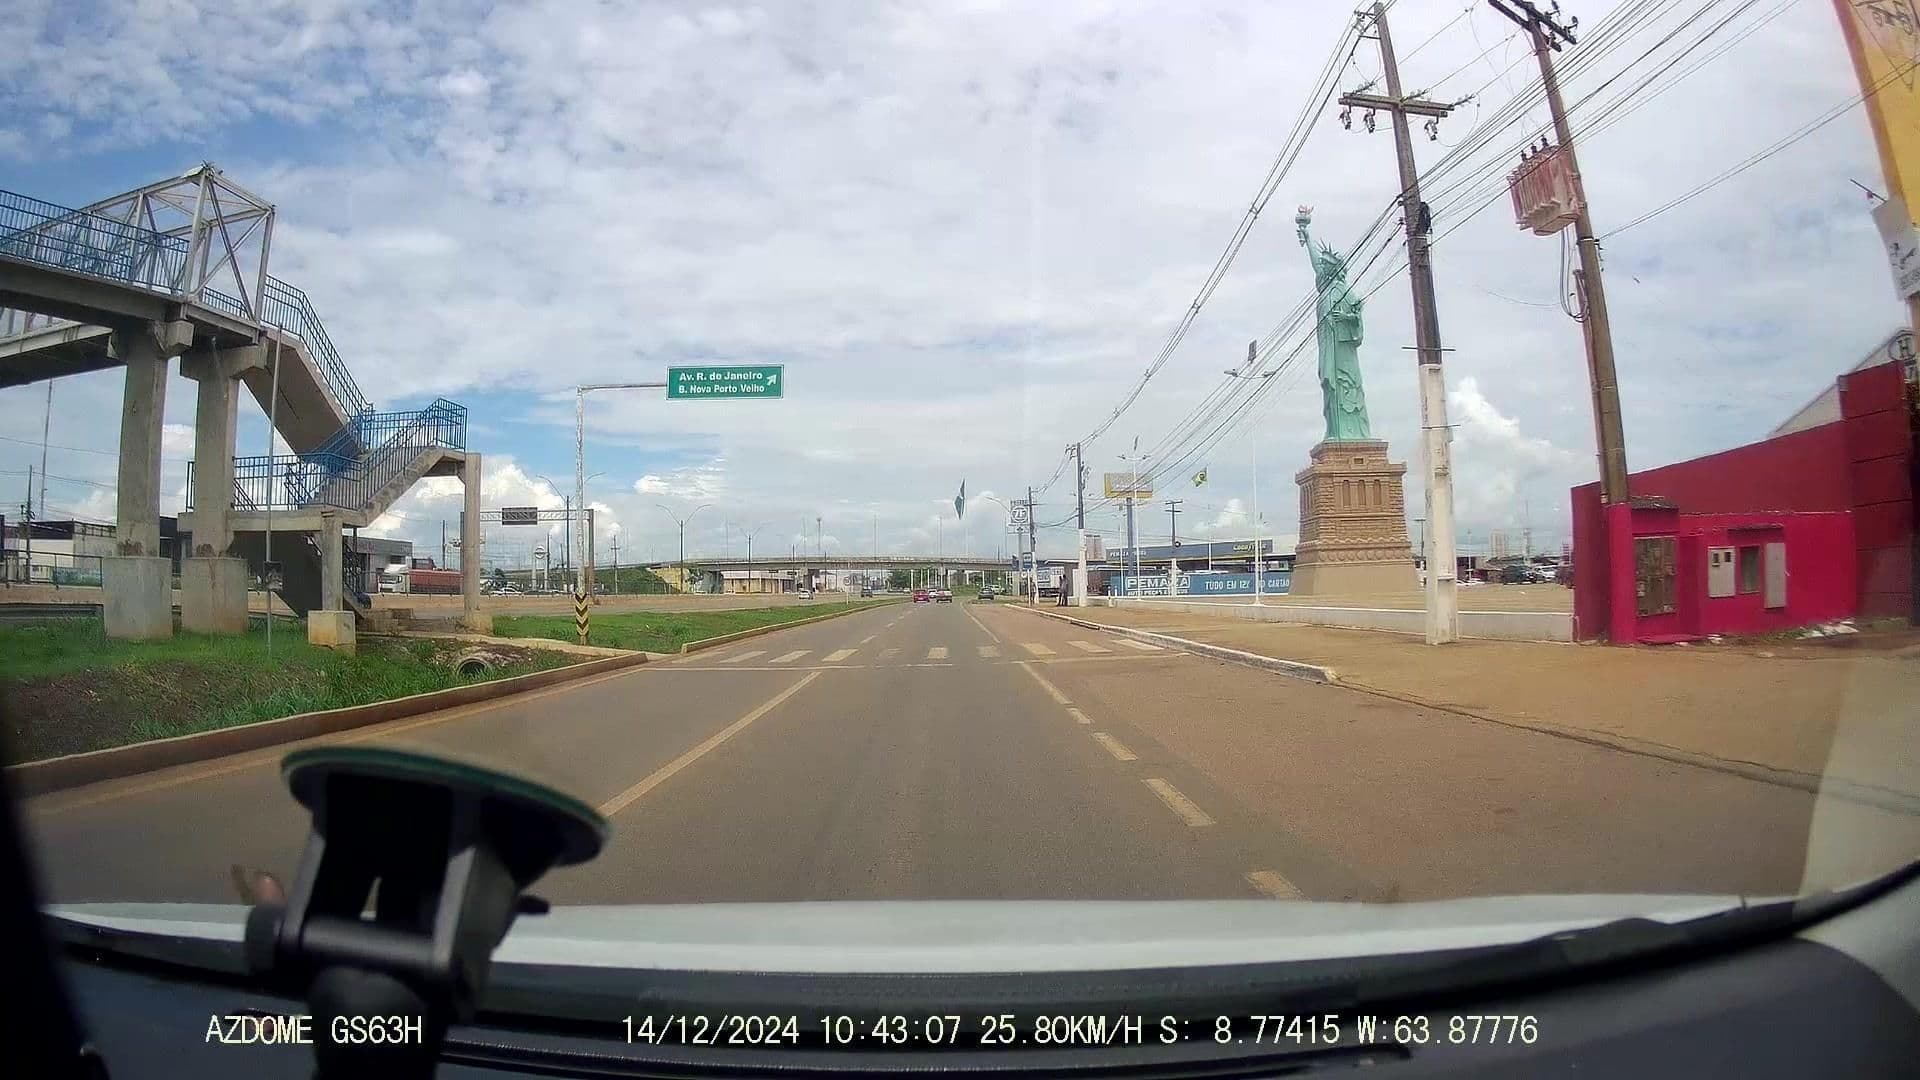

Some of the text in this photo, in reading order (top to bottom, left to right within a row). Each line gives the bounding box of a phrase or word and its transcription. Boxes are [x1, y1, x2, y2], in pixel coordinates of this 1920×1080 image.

[679, 371, 763, 381] Av. R. de Janeiro
[678, 384, 765, 394] B. Nova Porto Velho
[1127, 578, 1189, 588] PEMAA
[1205, 581, 1224, 590] TUDO
